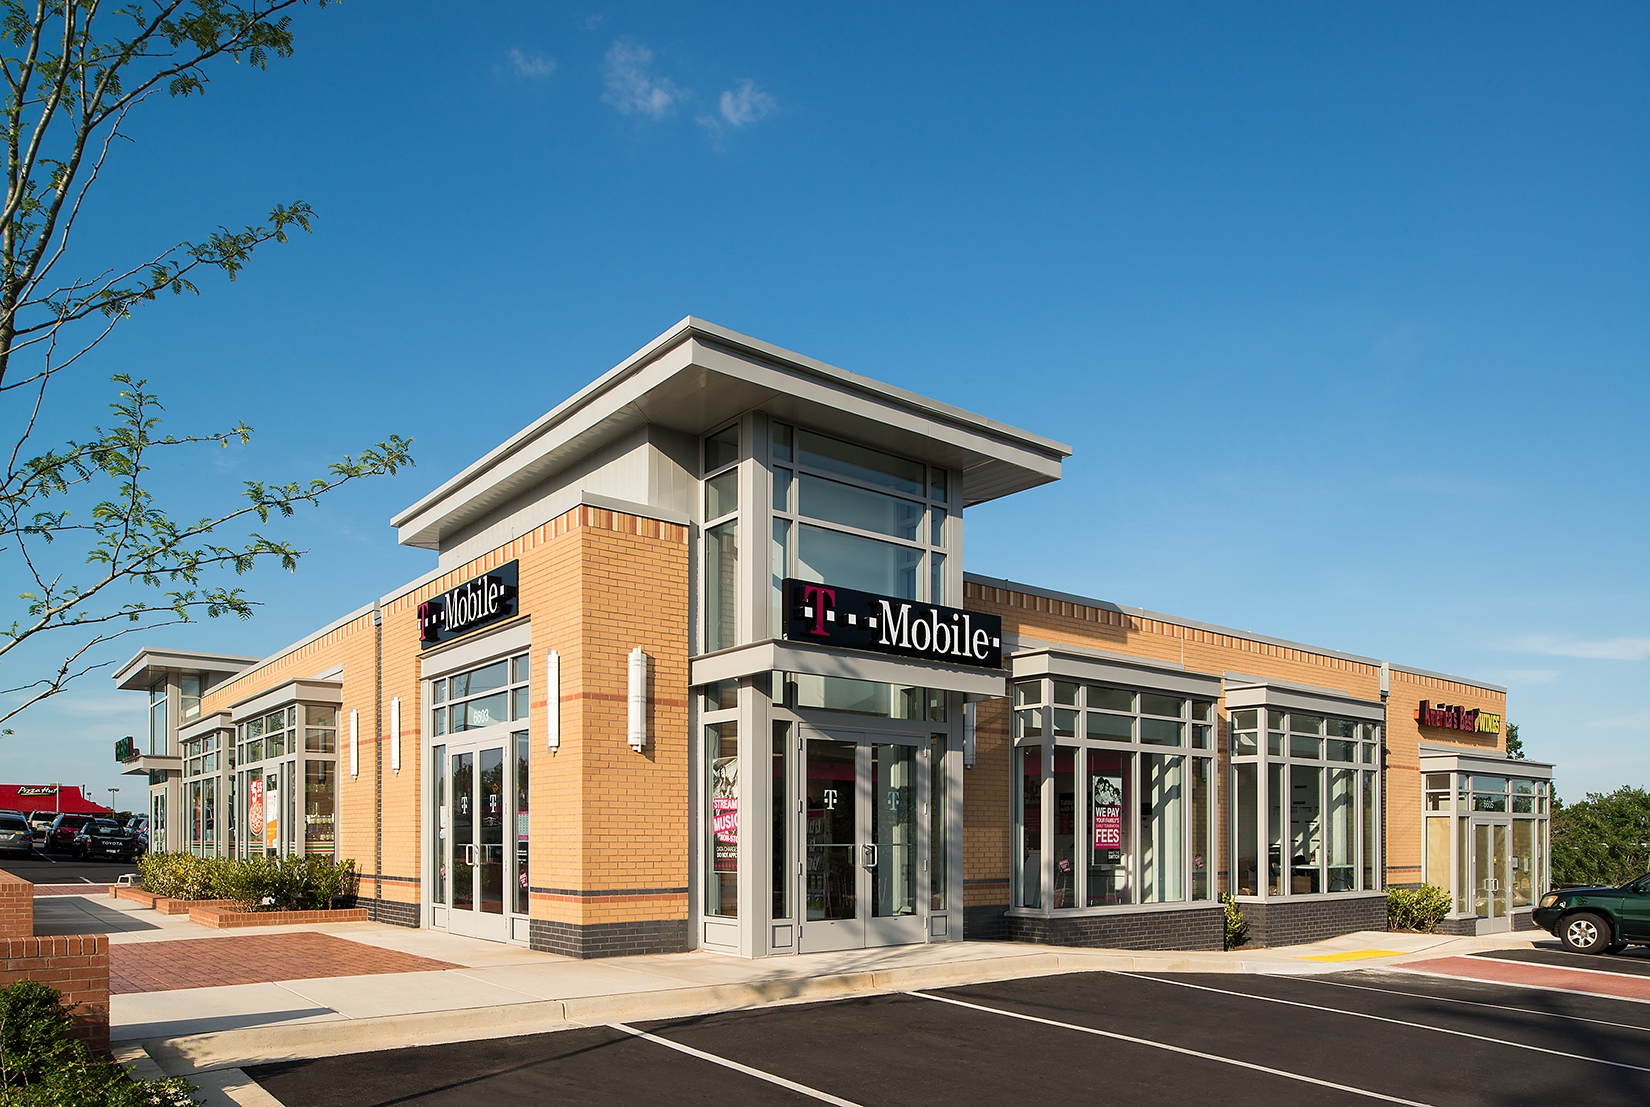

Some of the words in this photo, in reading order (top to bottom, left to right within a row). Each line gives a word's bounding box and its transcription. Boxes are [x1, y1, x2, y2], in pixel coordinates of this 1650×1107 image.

[473, 708, 489, 724] 6603
[1459, 704, 1475, 732] Best
[17, 786, 41, 795] Pizza
[41, 786, 58, 794] Hut
[1095, 807, 1107, 817] WE
[1107, 807, 1120, 818] PAY
[1095, 828, 1120, 843] FEES
